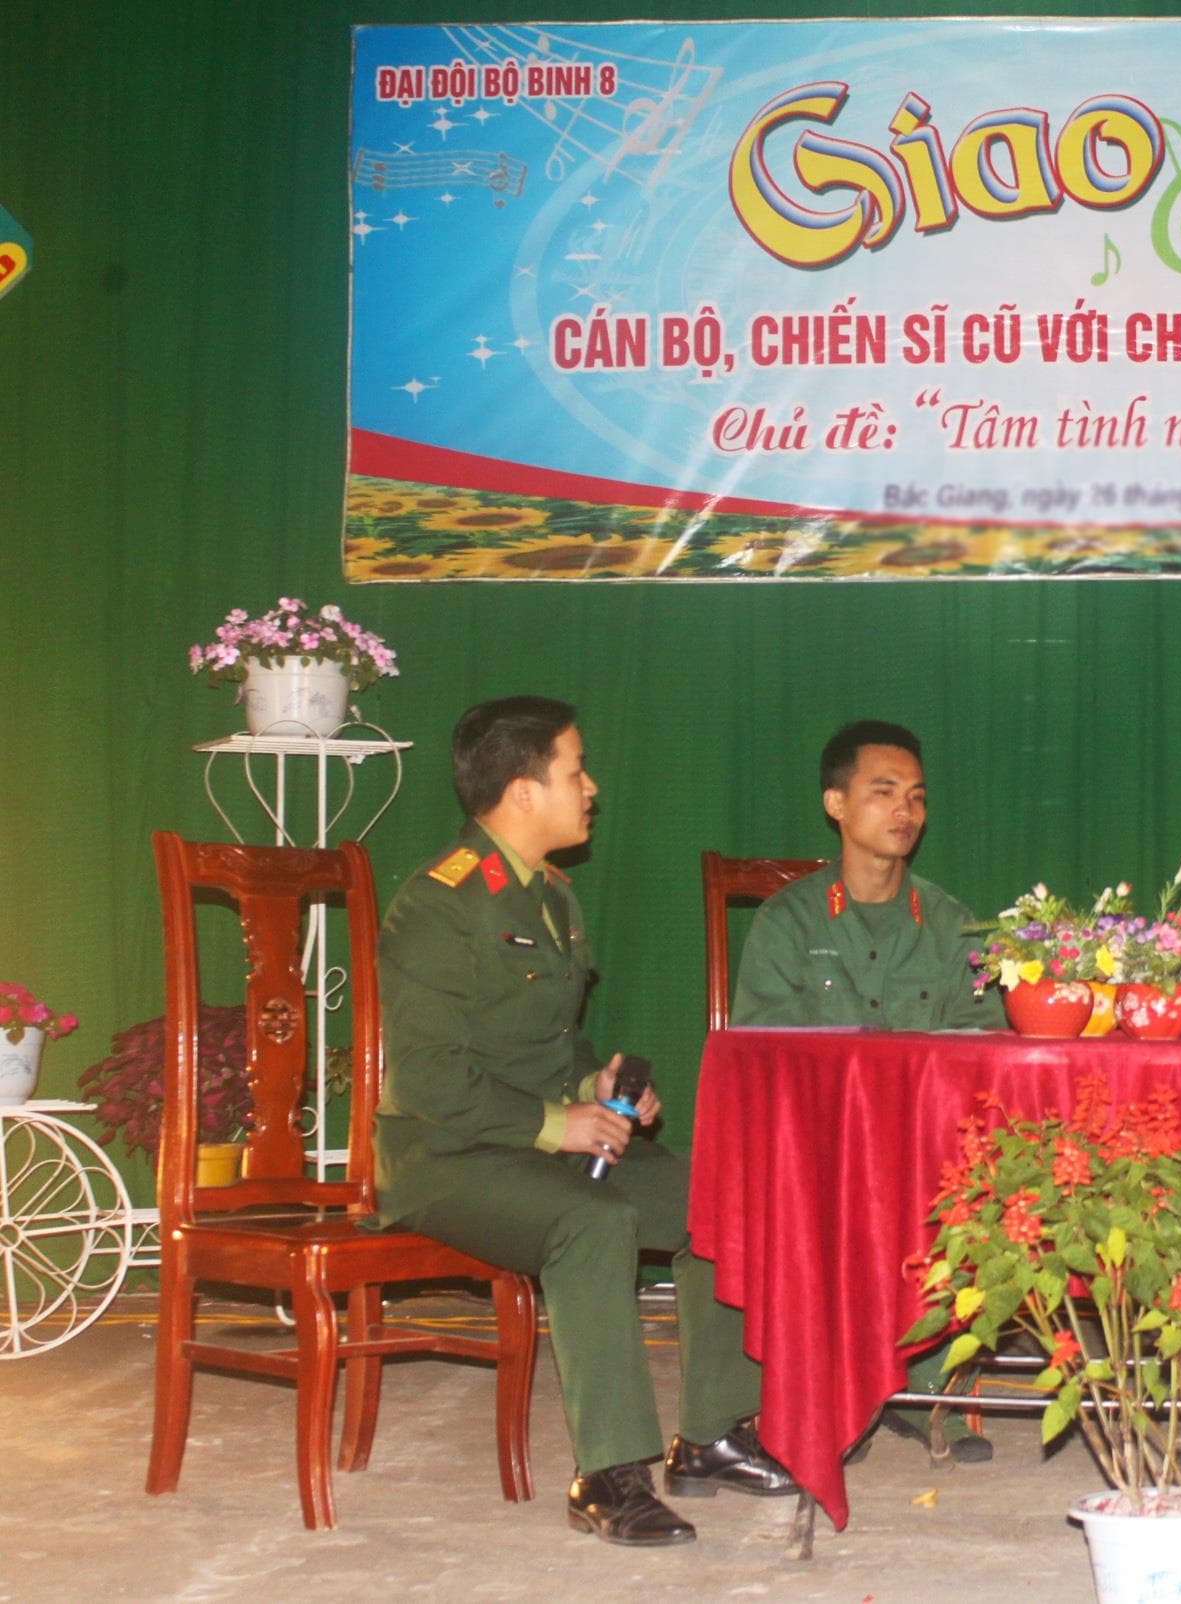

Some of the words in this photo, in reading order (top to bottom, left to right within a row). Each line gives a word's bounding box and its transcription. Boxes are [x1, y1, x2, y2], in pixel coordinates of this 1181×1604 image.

[379, 69, 423, 105] ĐẠI
[431, 62, 476, 105] ĐỘI
[484, 61, 519, 104] BỘ
[528, 66, 591, 96] BINH
[600, 66, 615, 96] 8
[730, 82, 1163, 270] Giao
[554, 308, 645, 368] CÁN
[663, 307, 735, 378] BỘ,
[752, 297, 885, 365] CHIẾN
[904, 305, 946, 364] SĨ
[964, 304, 1020, 364] CŨ
[1038, 298, 1108, 364] VỚI
[713, 406, 809, 451] Chủ
[825, 403, 896, 450] đề:
[1057, 395, 1148, 447] tình
